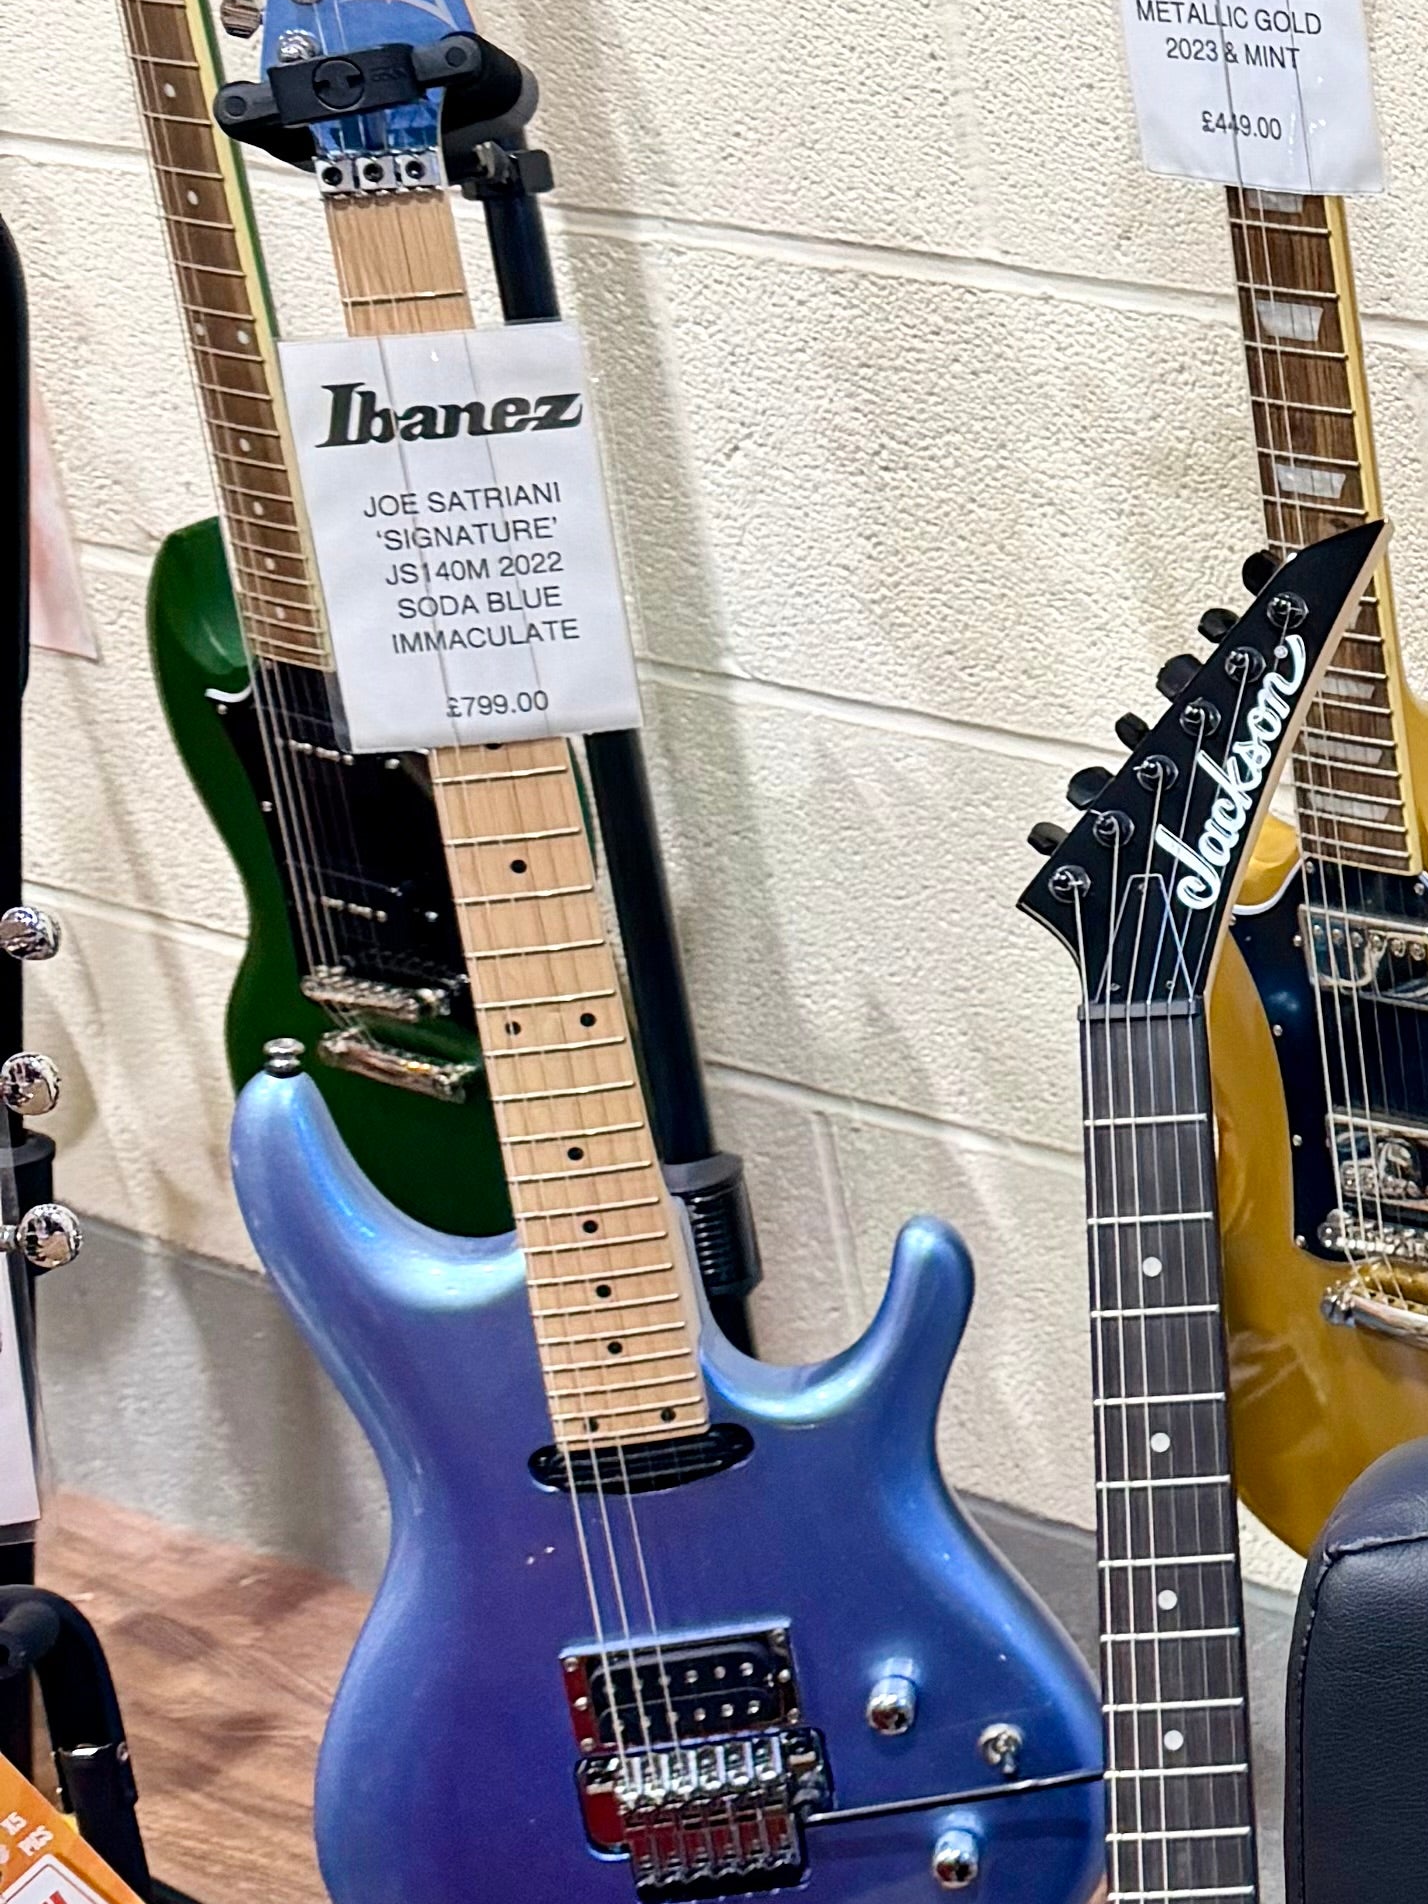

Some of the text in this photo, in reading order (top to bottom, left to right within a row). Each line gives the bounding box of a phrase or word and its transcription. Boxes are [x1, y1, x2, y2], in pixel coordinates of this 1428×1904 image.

[1136, 0, 1322, 36] METALLIC GOLD
[1166, 38, 1300, 70] 2023 & MINT
[1200, 109, 1282, 141] £449.00
[315, 382, 582, 449] Ibanez
[363, 481, 563, 519] JOE SATRIANI
[385, 551, 565, 587] JS140M 2022
[397, 586, 564, 620] SODA BLUE
[391, 618, 580, 656] IMMACULATE
[446, 689, 550, 719] £799.00
[1155, 633, 1306, 911] Jackson
